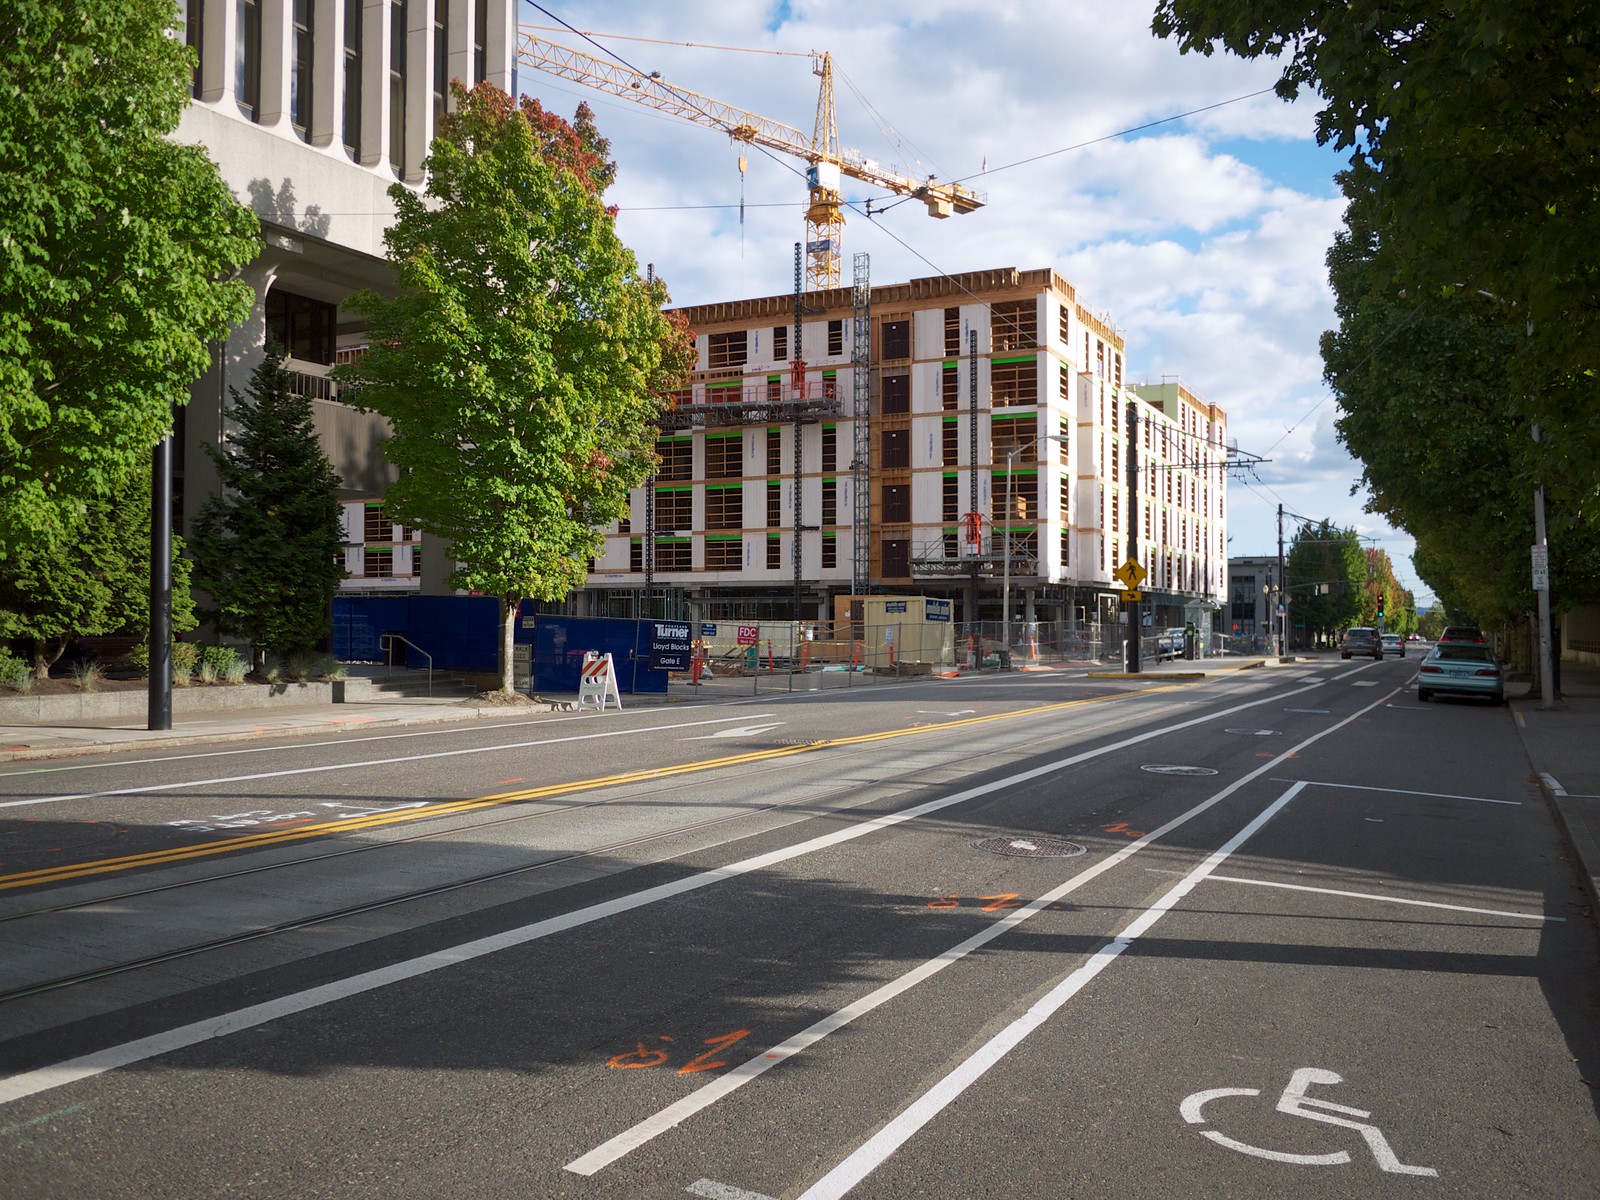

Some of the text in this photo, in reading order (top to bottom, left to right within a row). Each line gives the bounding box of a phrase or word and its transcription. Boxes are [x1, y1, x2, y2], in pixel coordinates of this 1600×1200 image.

[654, 624, 689, 638] Turner
[740, 627, 757, 637] FDC
[653, 643, 690, 651] Lloyd Blocks
[659, 657, 676, 665] Gate
